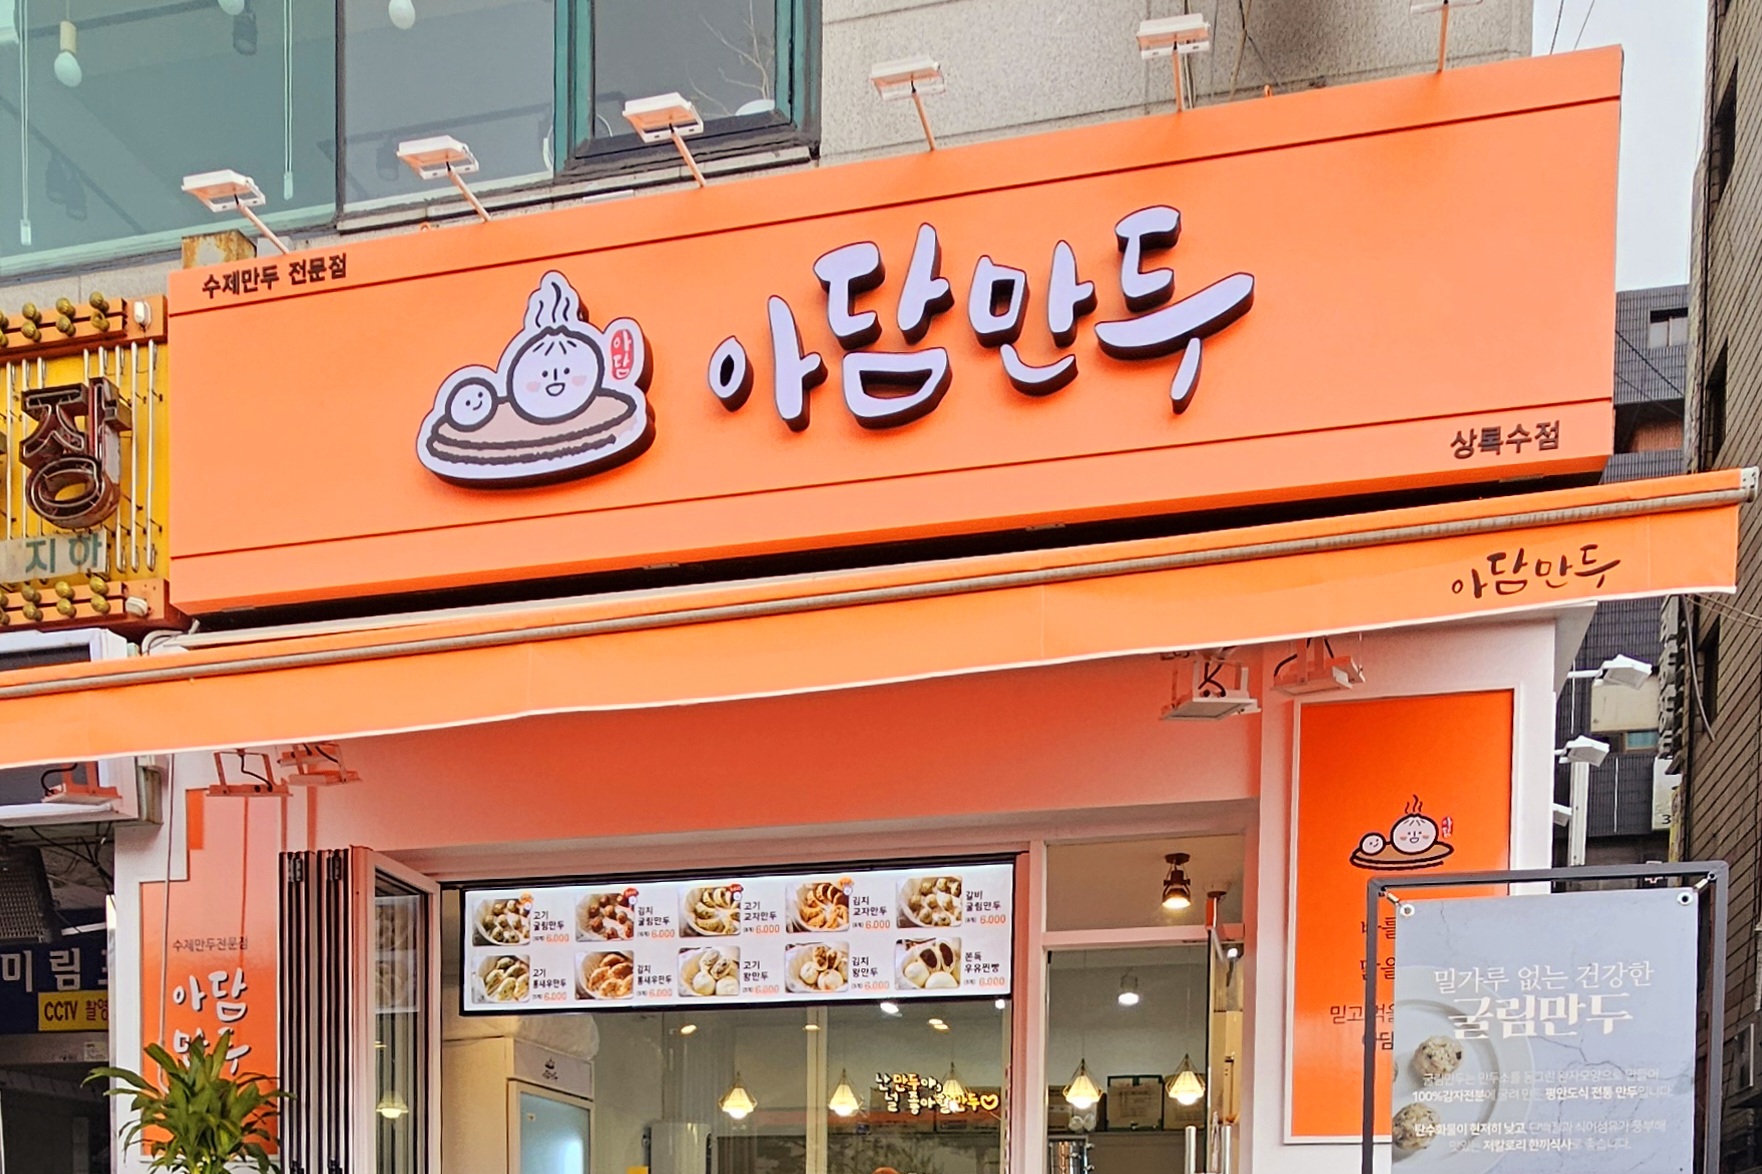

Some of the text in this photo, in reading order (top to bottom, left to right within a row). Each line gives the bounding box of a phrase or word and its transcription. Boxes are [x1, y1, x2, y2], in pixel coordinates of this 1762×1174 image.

[201, 252, 347, 300] 수제만두 전문점
[707, 204, 1255, 432] 아담만두
[1450, 420, 1561, 460] 상록수점
[24, 533, 103, 574] 지하
[1451, 543, 1621, 599] 아담만두
[743, 901, 761, 911] 고기
[965, 890, 983, 901] 갈비
[533, 911, 549, 920] 고기
[172, 936, 249, 953] 수제만두전문점
[532, 968, 546, 978] 고기
[743, 960, 761, 970] 고기
[1433, 960, 1656, 995] 밀가루 없는 건강한
[172, 967, 249, 1023] 아담
[44, 1000, 79, 1022] CCTV
[1448, 992, 1634, 1040] 굴림만두
[1414, 1123, 1468, 1138] 탄수화물이
[1469, 1122, 1502, 1137] 현저히
[1483, 1138, 1527, 1154] 저칼로리
